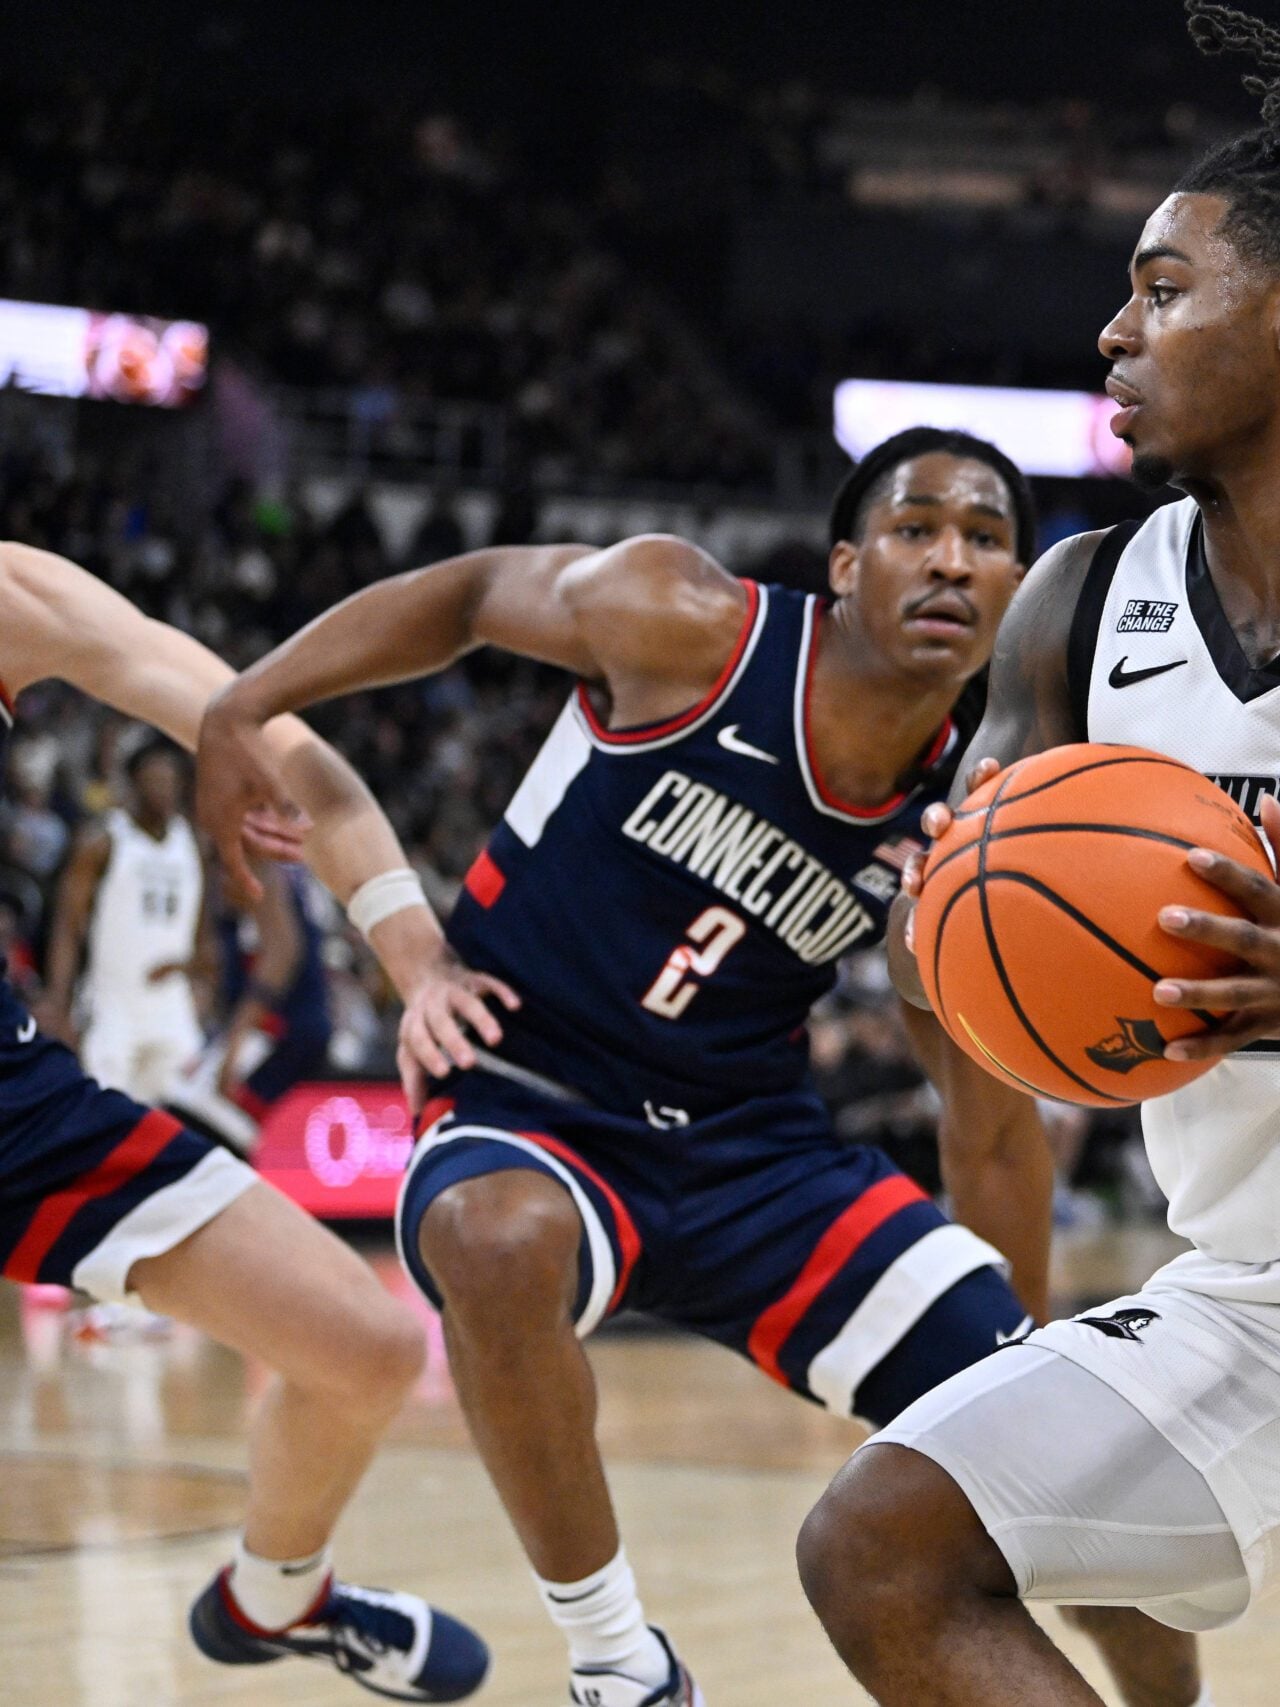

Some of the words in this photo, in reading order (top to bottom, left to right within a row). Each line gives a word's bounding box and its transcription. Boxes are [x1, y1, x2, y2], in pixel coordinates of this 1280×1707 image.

[1117, 616, 1173, 632] CHANGE
[1124, 600, 1145, 616] BE
[1146, 602, 1177, 617] THE
[621, 770, 876, 966] CONNECTICUT
[641, 905, 747, 1021] 2
